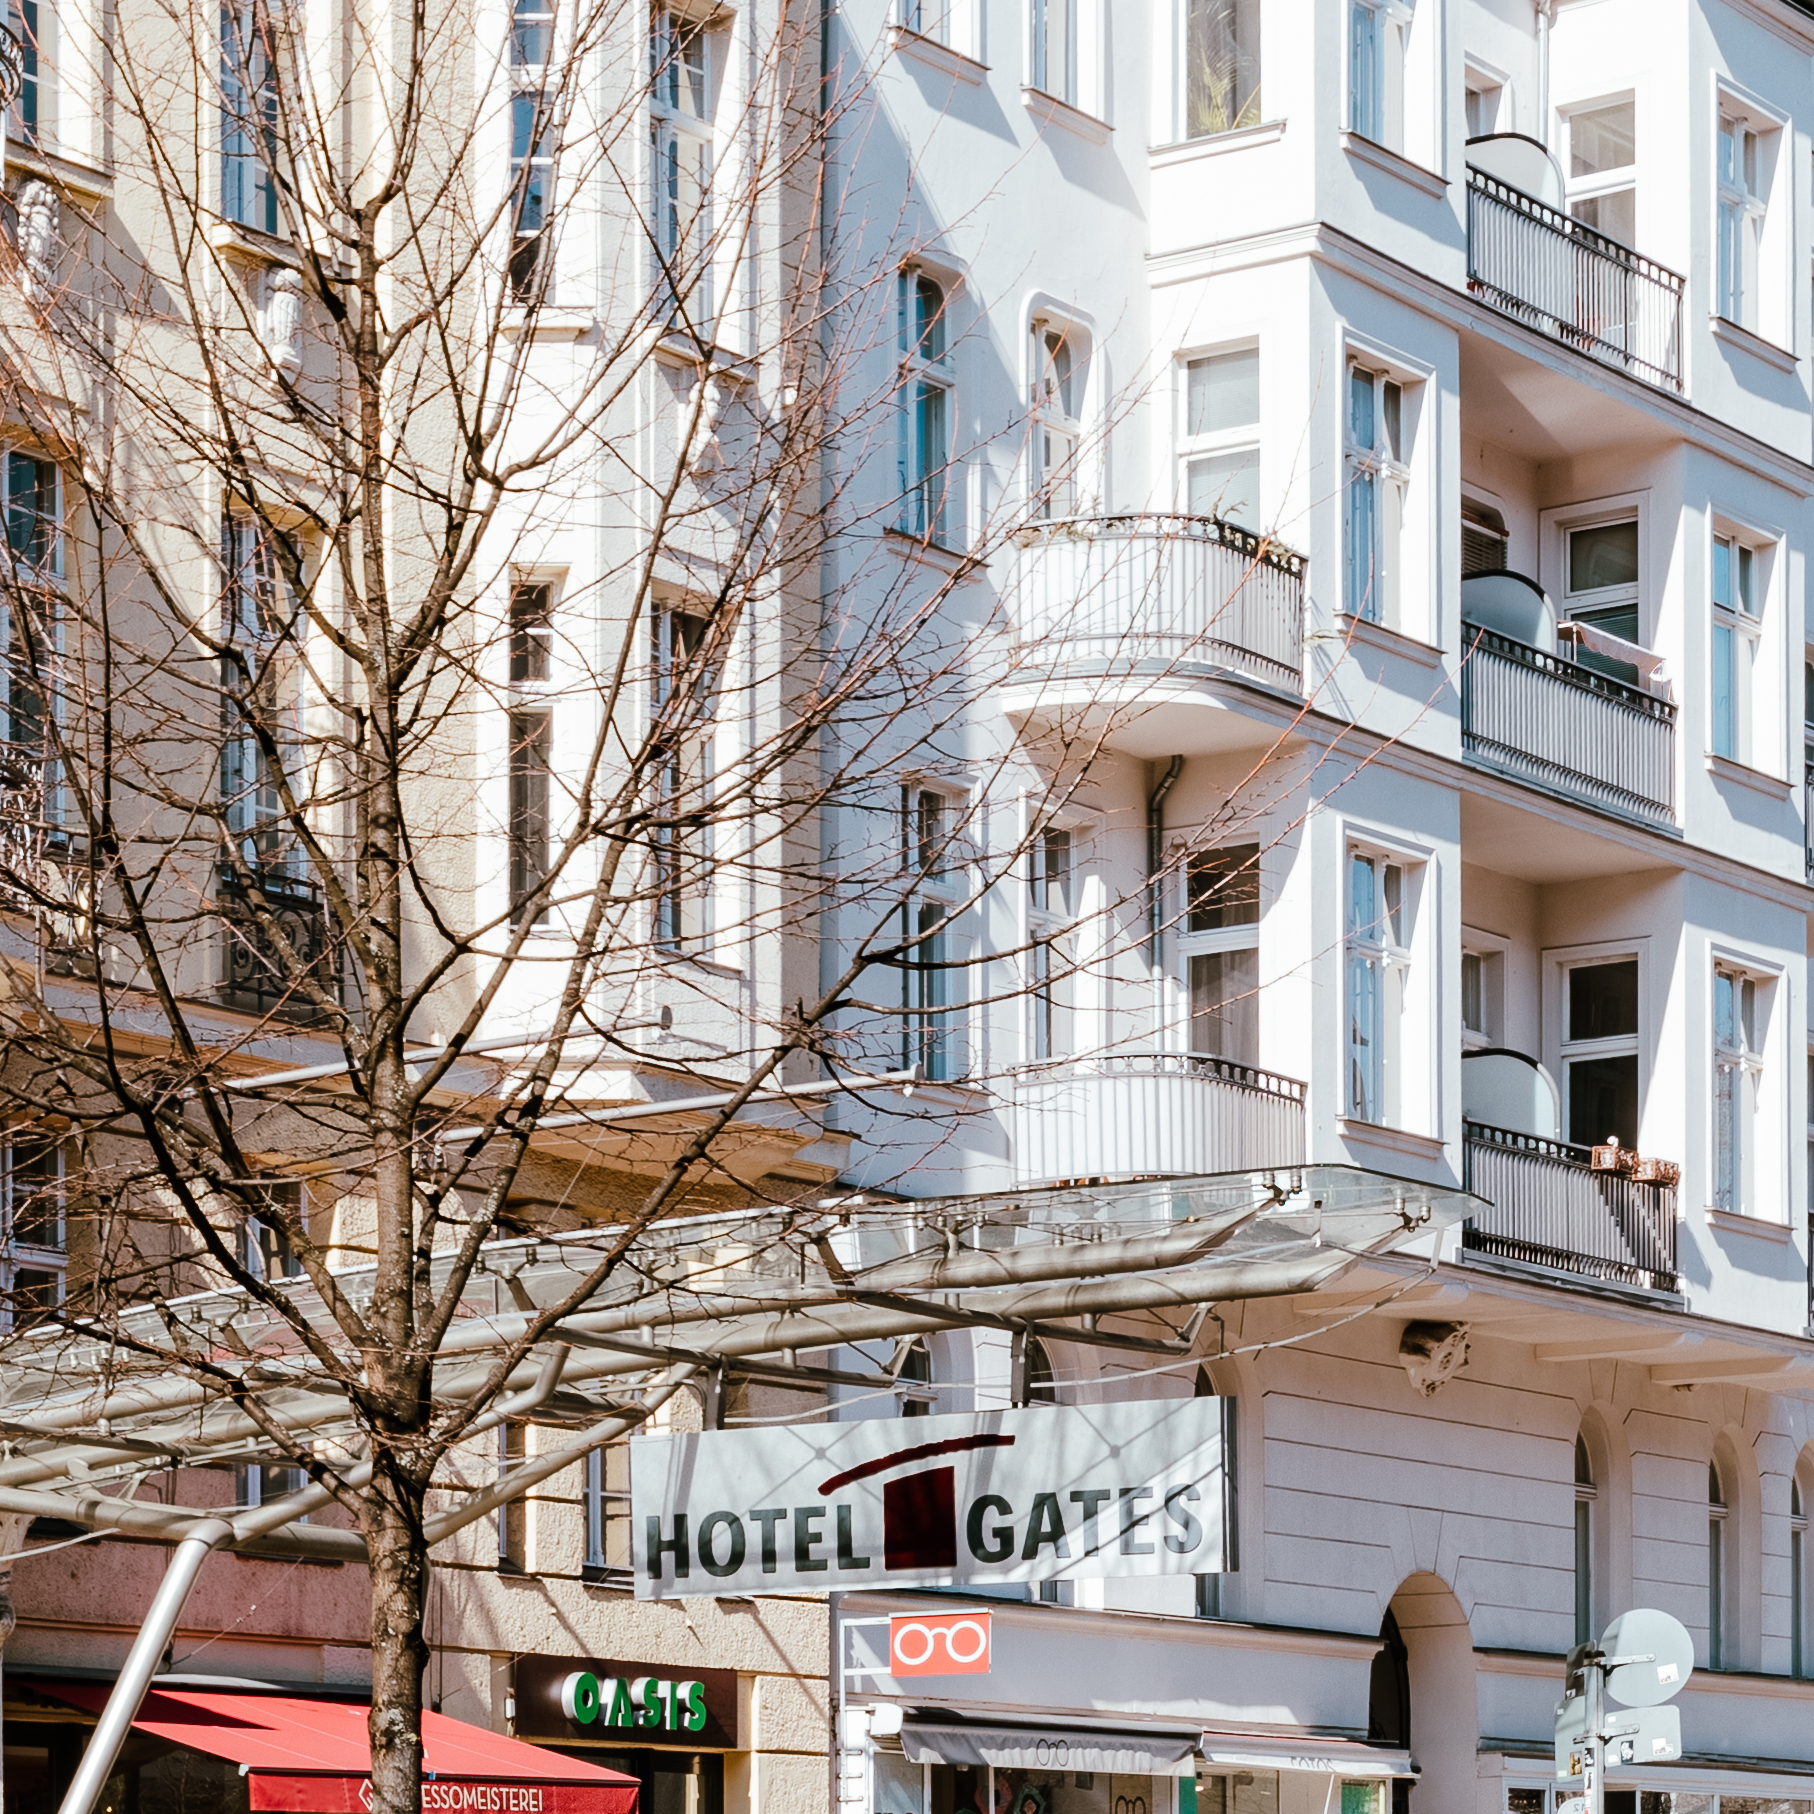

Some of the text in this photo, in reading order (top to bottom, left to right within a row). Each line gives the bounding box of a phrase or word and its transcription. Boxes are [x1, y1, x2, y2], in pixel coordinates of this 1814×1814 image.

[645, 1483, 1203, 1580] HOTEL GATES
[561, 1672, 707, 1732] OASIS
[422, 1785, 542, 1812] ESSOMEISTEREI
